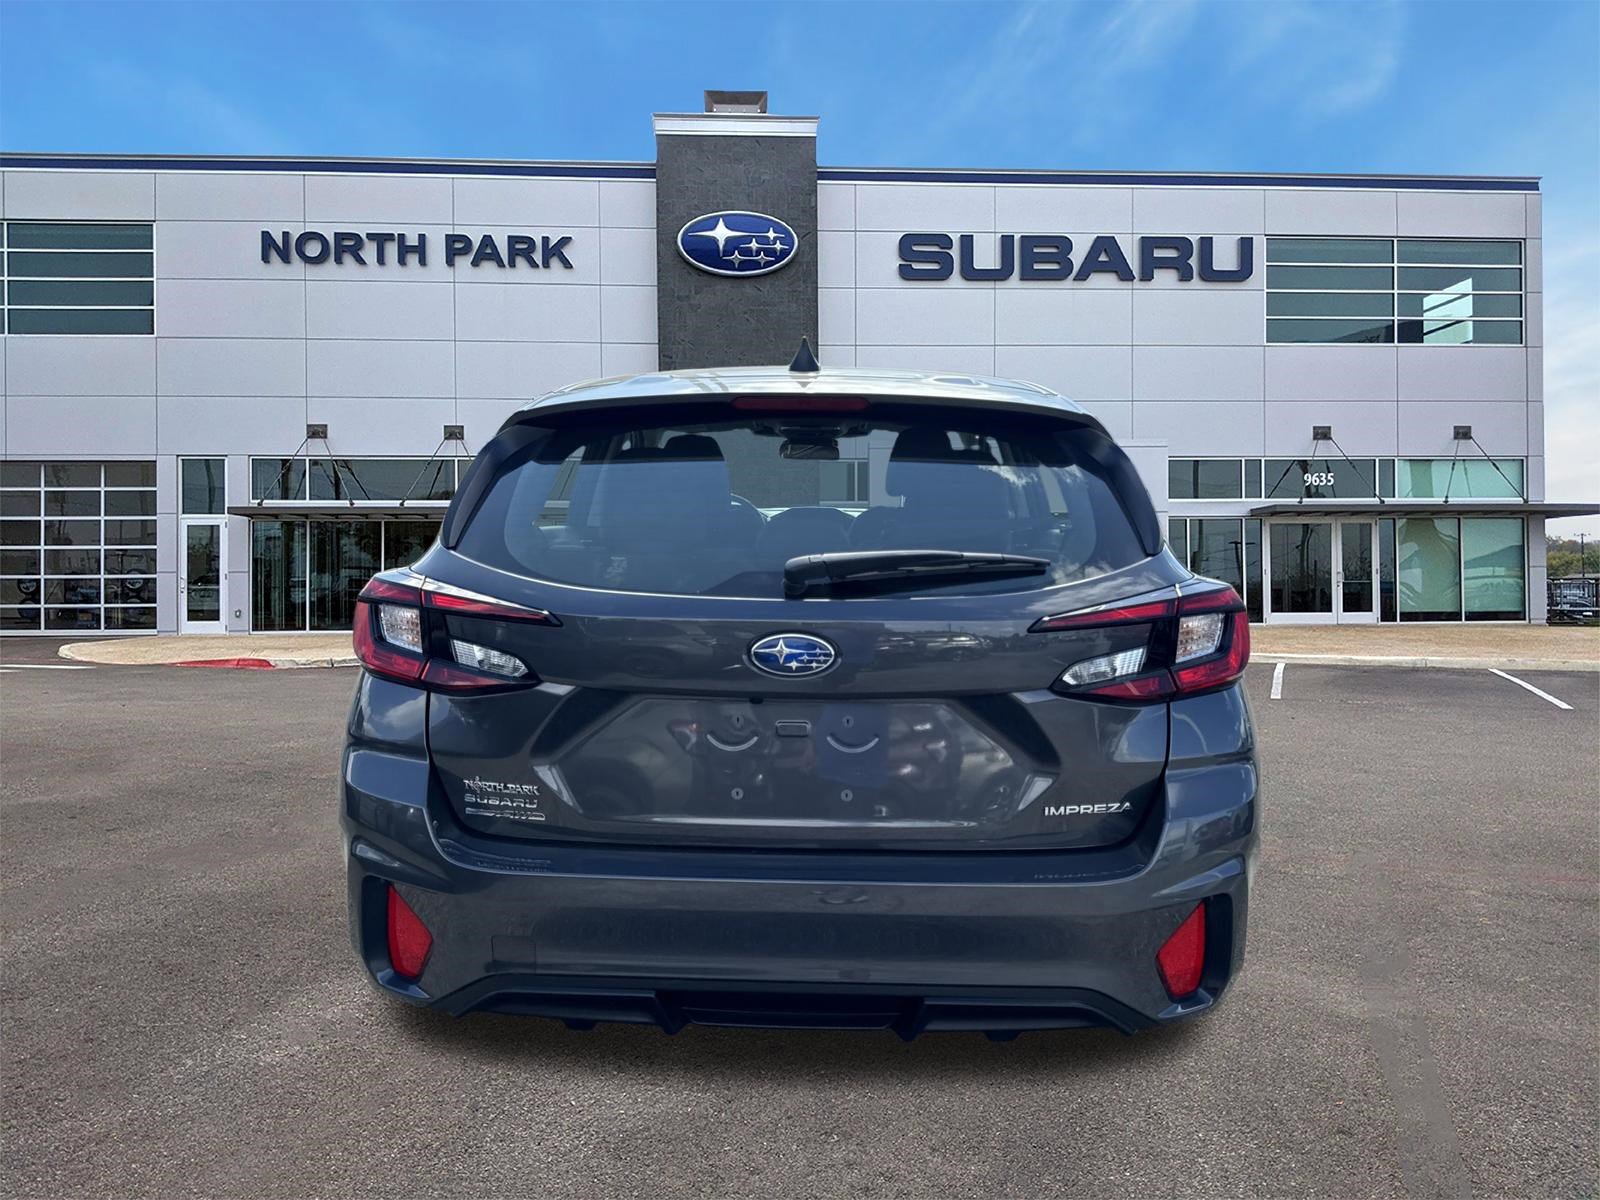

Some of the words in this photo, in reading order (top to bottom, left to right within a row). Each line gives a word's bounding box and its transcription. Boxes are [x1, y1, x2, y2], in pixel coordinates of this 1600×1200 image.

[260, 230, 427, 267] NORTH
[444, 233, 574, 270] PARK
[898, 233, 1254, 282] SUBARU
[1303, 472, 1335, 486] 9635
[463, 776, 505, 793] NORTH
[506, 783, 540, 796] PARK
[464, 793, 538, 808] SUBARU
[1044, 801, 1132, 816] IMPREZA
